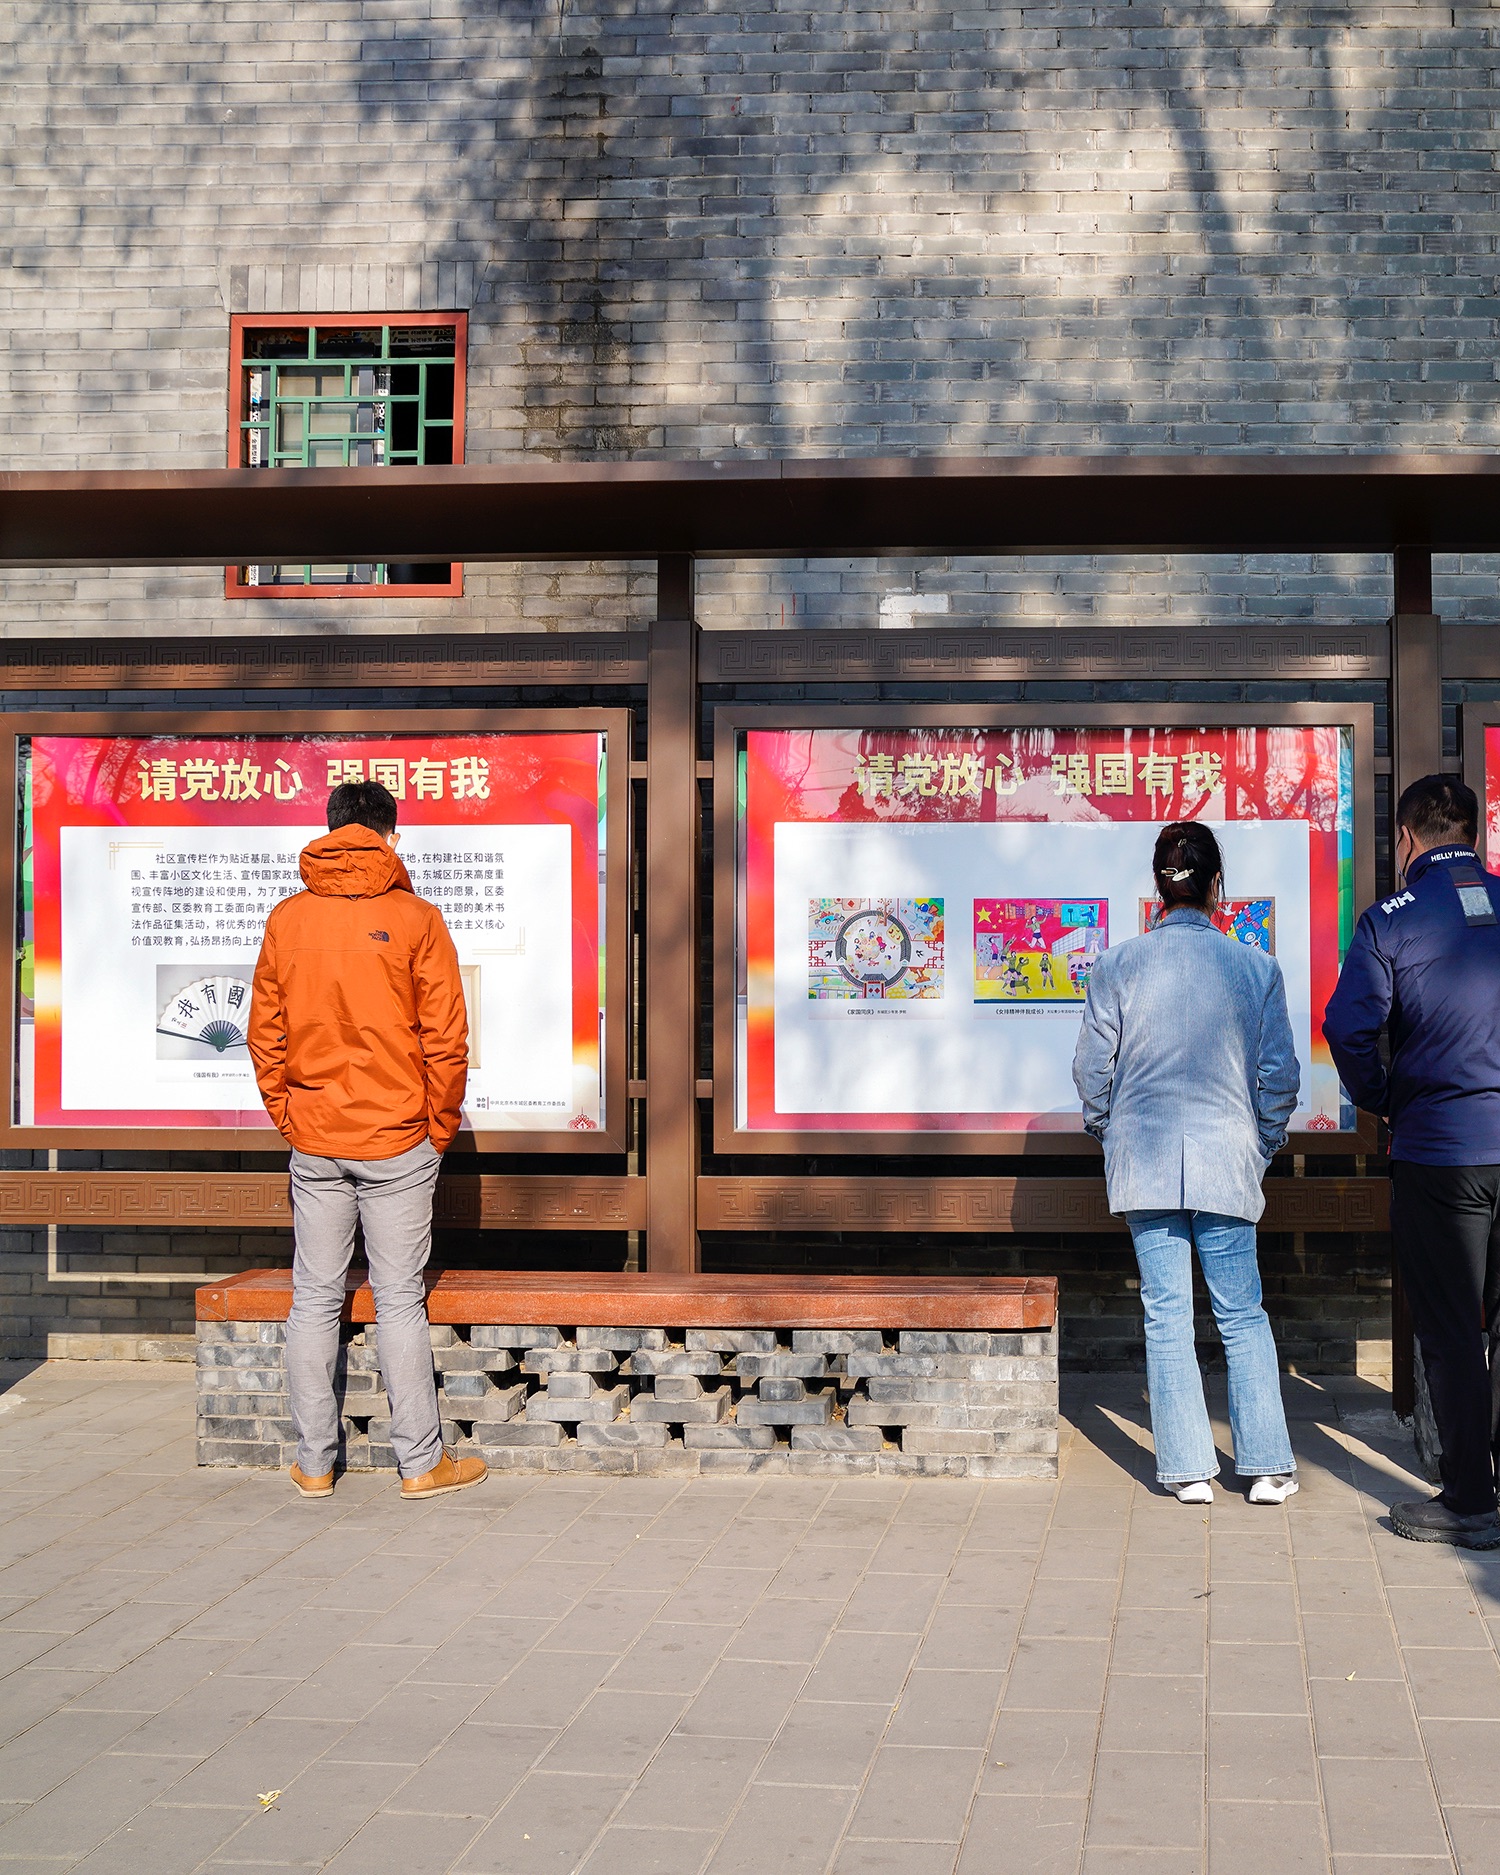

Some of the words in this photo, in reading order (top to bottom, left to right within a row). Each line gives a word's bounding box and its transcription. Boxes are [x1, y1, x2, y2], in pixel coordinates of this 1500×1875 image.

[137, 757, 303, 801] 请党放心
[853, 751, 1026, 798] 请党放心
[1050, 751, 1224, 797] 强国有我
[155, 853, 301, 865] 社区宣传栏作为贴近基层、贴近
[1430, 850, 1453, 862] HELLY
